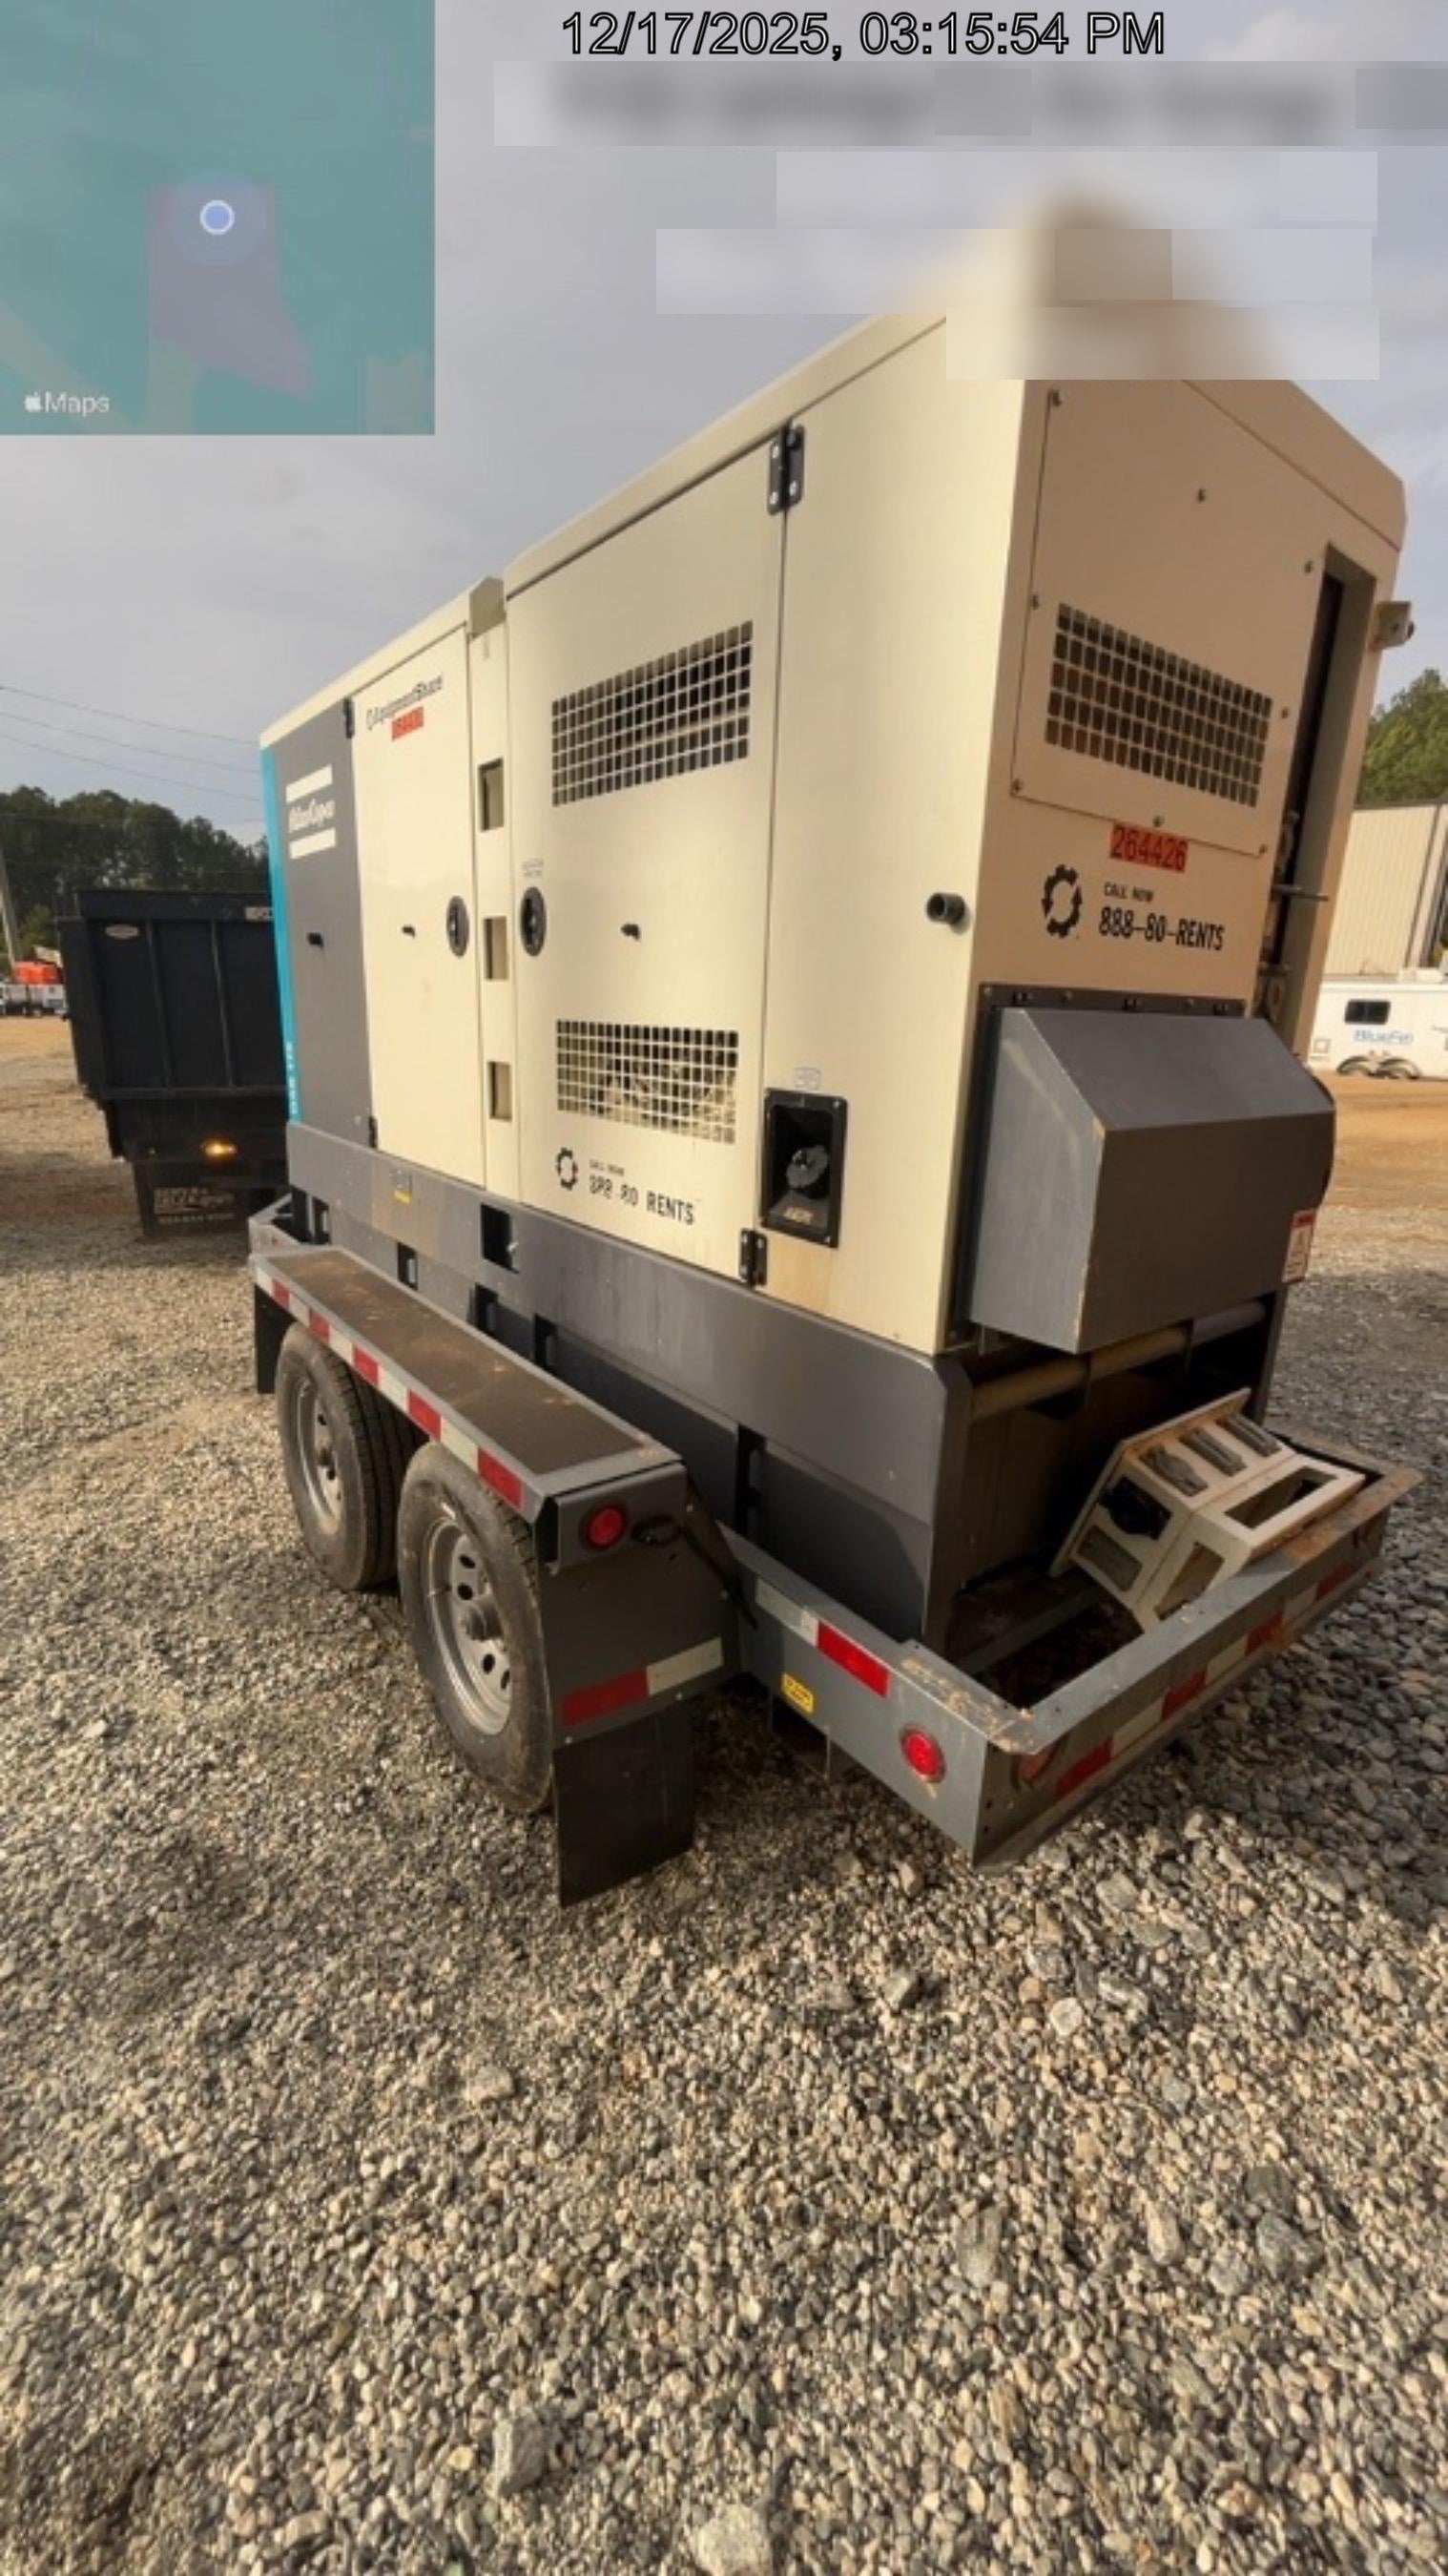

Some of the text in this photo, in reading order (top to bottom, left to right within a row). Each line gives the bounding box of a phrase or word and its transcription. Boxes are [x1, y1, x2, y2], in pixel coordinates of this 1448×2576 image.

[1111, 826, 1188, 871] 264426
[1104, 882, 1154, 902] CALL NOW
[1099, 906, 1225, 951] 888-80-RENTS
